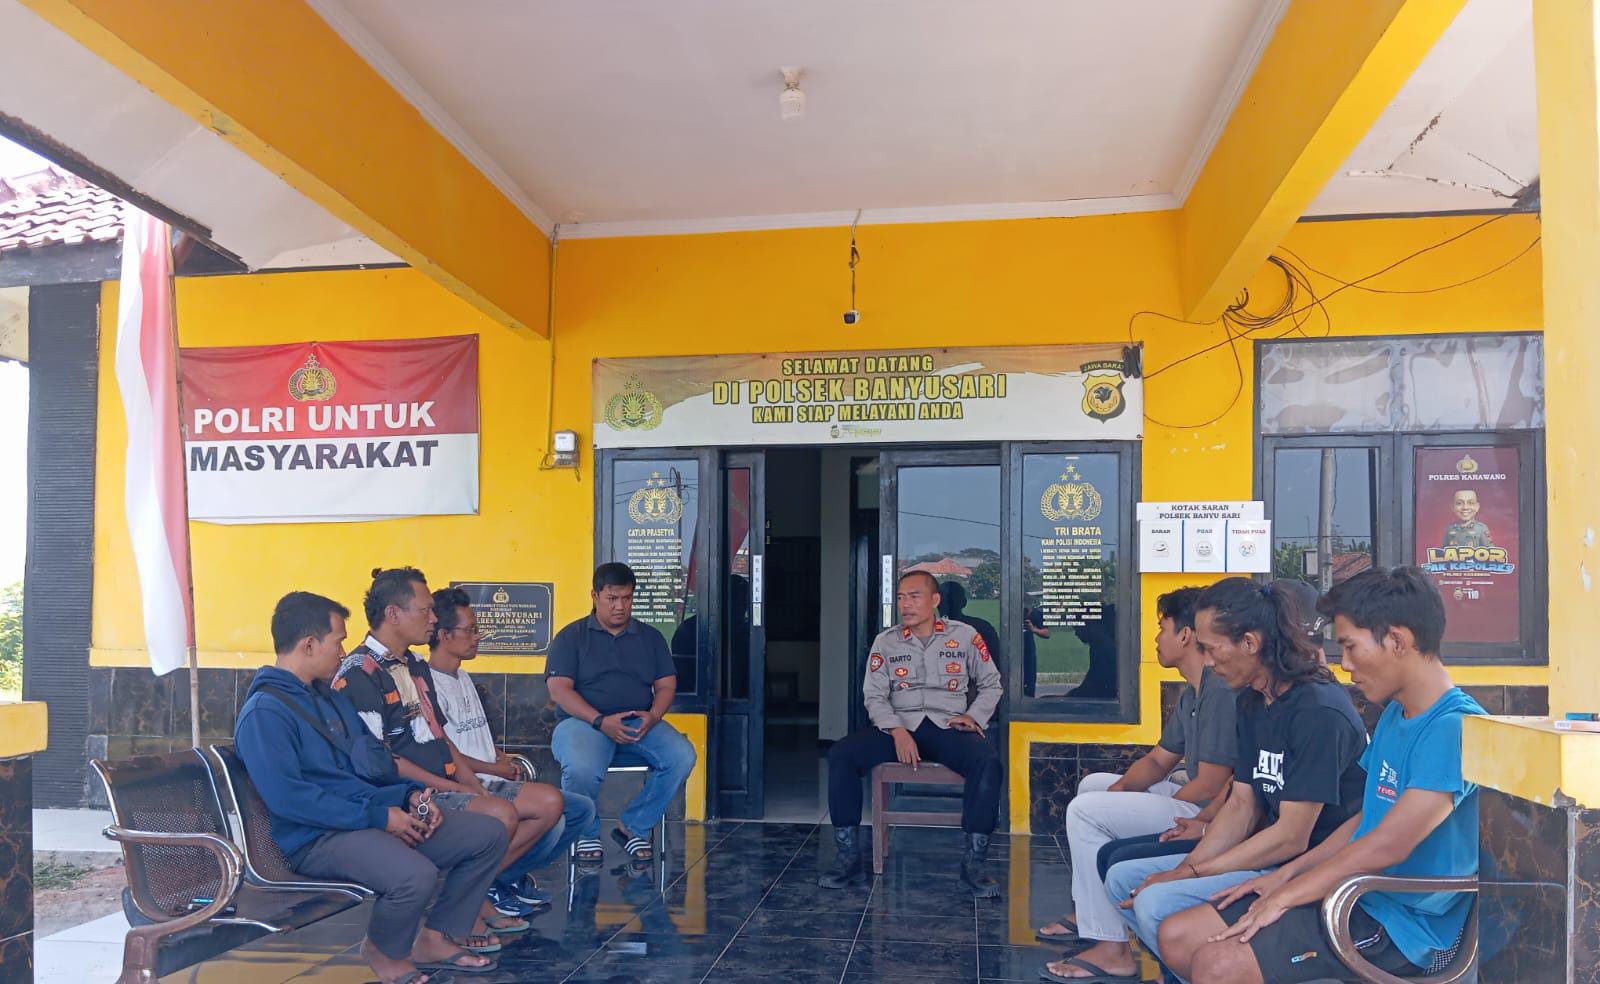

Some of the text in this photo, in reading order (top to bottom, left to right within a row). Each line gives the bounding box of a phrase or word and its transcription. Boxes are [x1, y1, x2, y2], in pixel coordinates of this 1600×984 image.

[782, 355, 934, 375] SELAMAT DATANG
[713, 374, 1007, 405] DI POLSEK BANYUSARI
[194, 401, 436, 434] POLRI UNTUK
[752, 401, 963, 423] KAMI SIAP MELAYANI ANDA
[190, 440, 438, 472] MASYARAKAT
[628, 528, 675, 537] CATUR PRASETYA
[1054, 526, 1102, 536] TRI BRATA
[1428, 547, 1507, 563] LAPOR
[939, 651, 966, 659] POLRI
